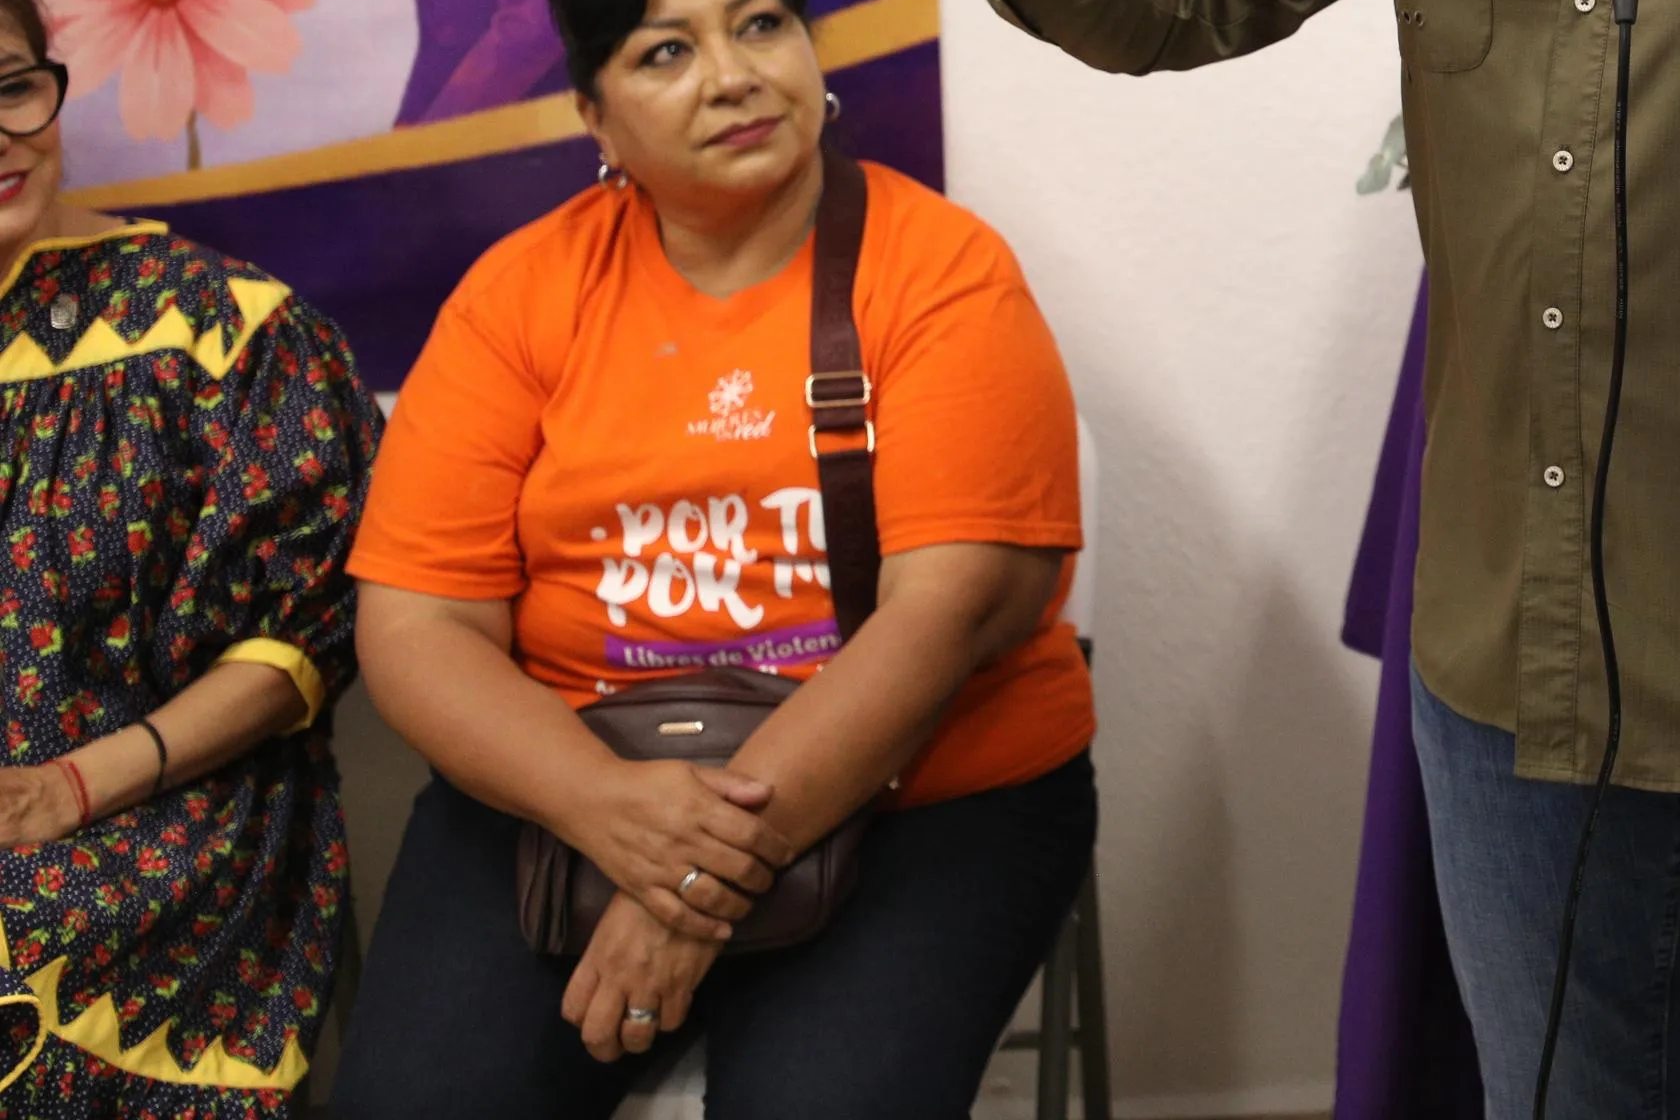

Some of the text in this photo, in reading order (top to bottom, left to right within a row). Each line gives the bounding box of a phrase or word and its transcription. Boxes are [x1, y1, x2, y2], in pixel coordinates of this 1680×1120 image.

[616, 494, 758, 564] POR
[596, 552, 764, 629] POR
[708, 648, 744, 667] de
[745, 633, 842, 663] Violen
